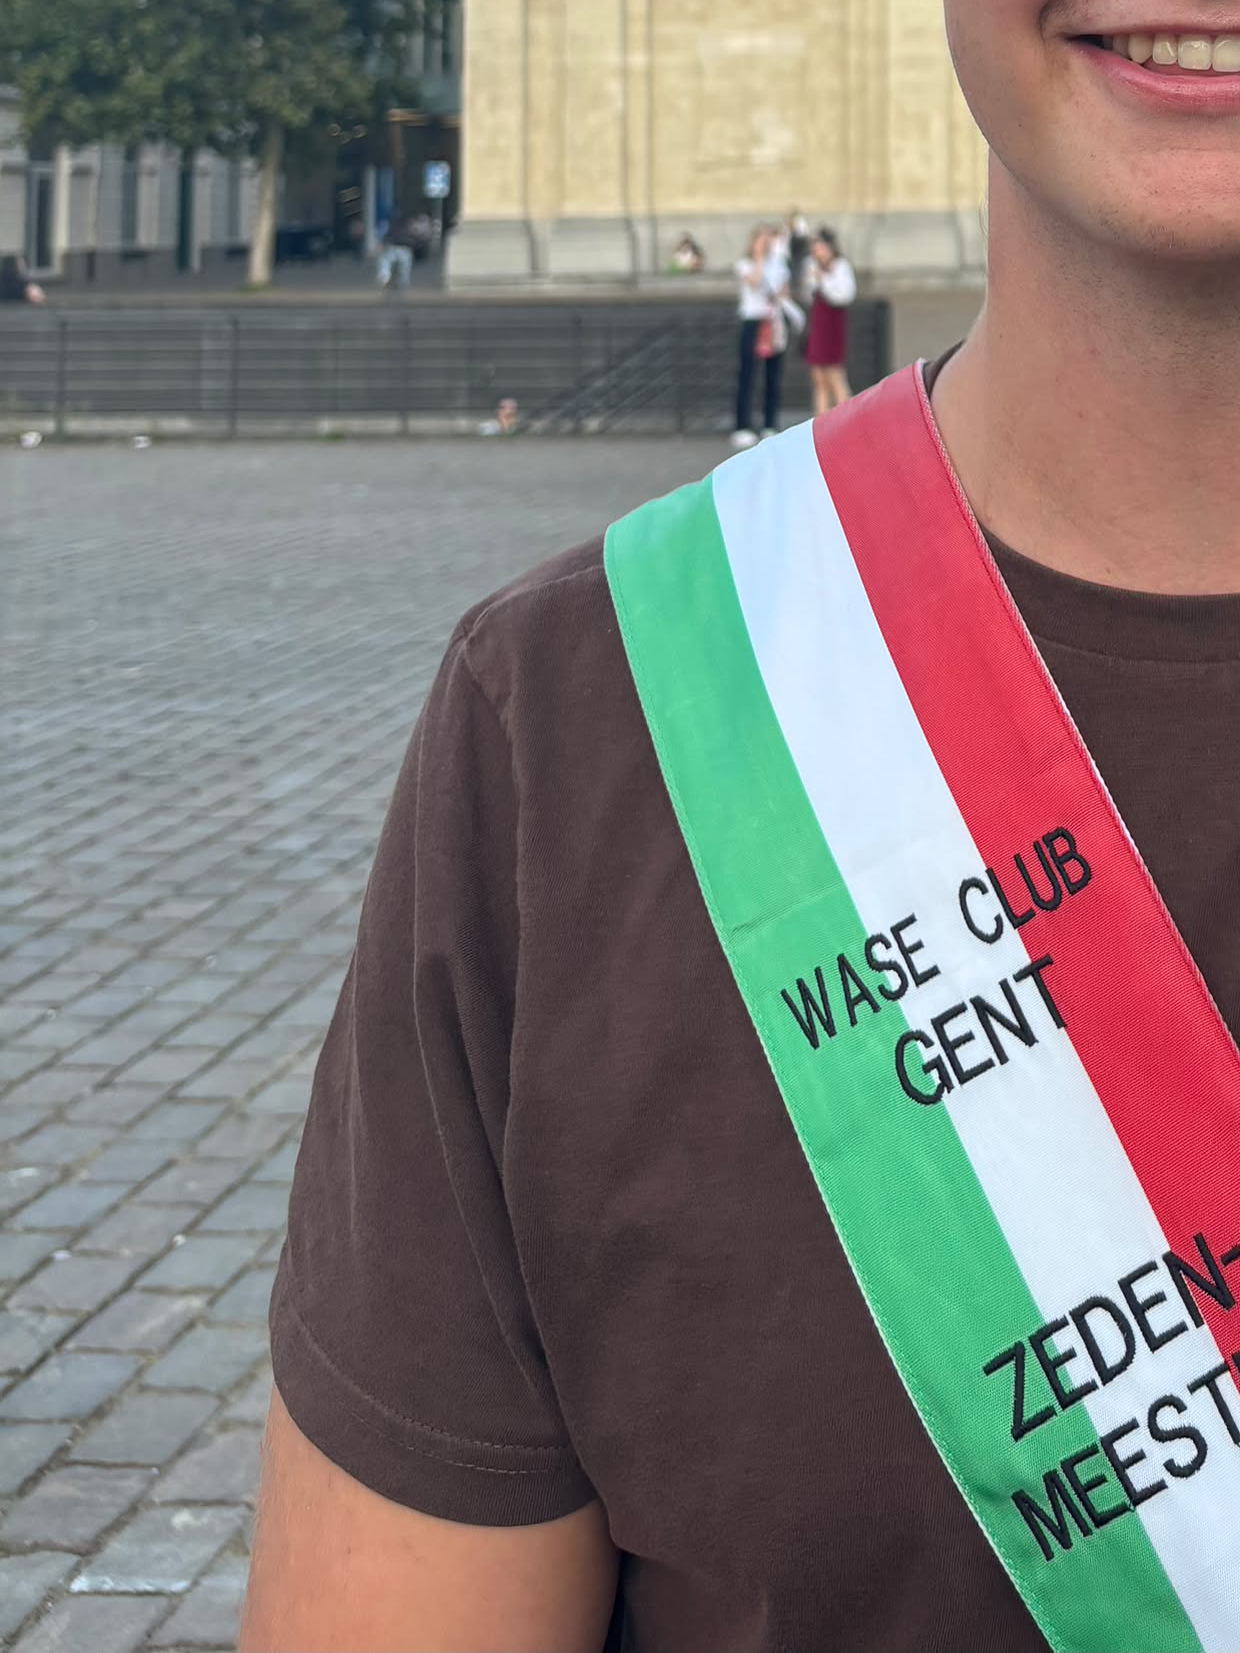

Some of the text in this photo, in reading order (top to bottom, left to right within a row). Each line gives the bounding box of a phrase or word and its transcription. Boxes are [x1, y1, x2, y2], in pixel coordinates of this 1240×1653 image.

[781, 827, 1092, 1049] WASE CLUB
[895, 956, 1067, 1106] GENT
